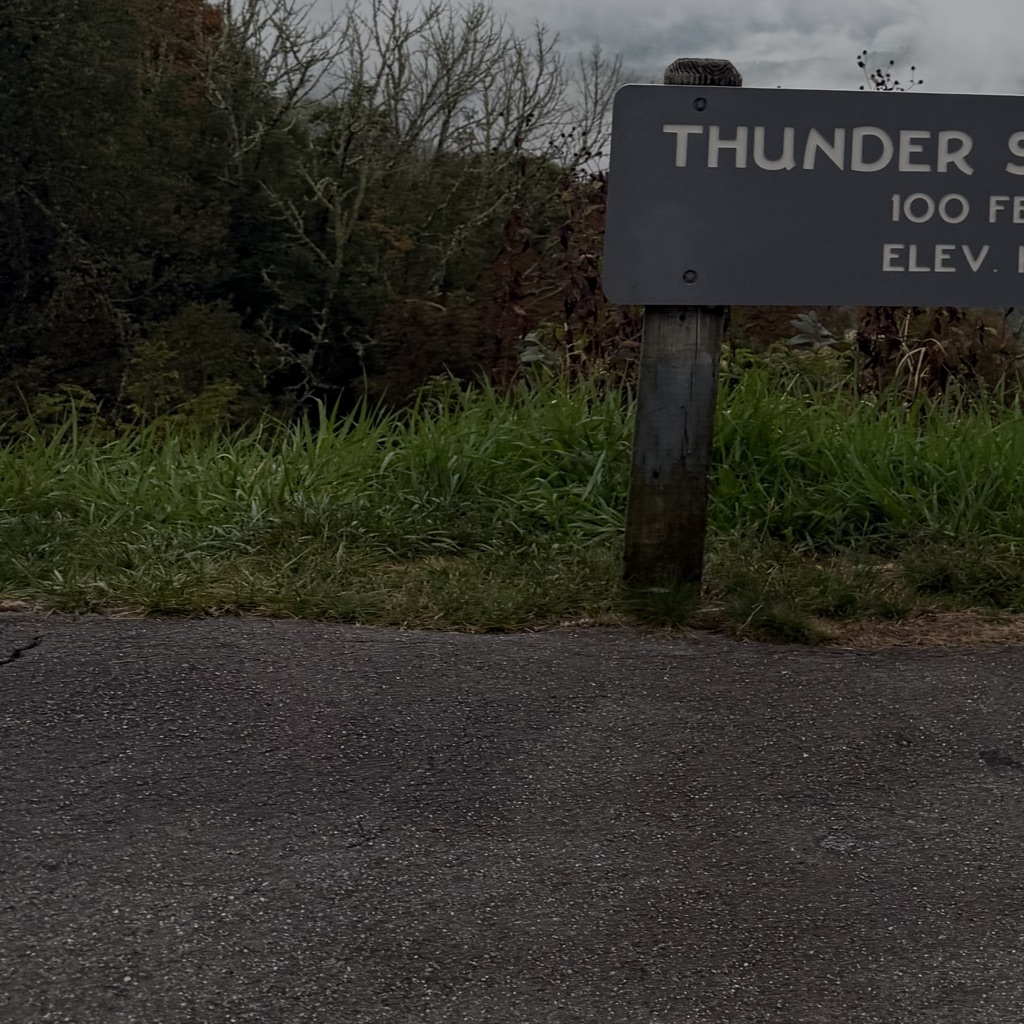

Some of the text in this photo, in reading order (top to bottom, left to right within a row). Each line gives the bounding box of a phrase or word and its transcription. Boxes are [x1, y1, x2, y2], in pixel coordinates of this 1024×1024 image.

[662, 124, 974, 176] THUNDER
[891, 192, 970, 224] 100
[882, 243, 998, 273] ELEV.
